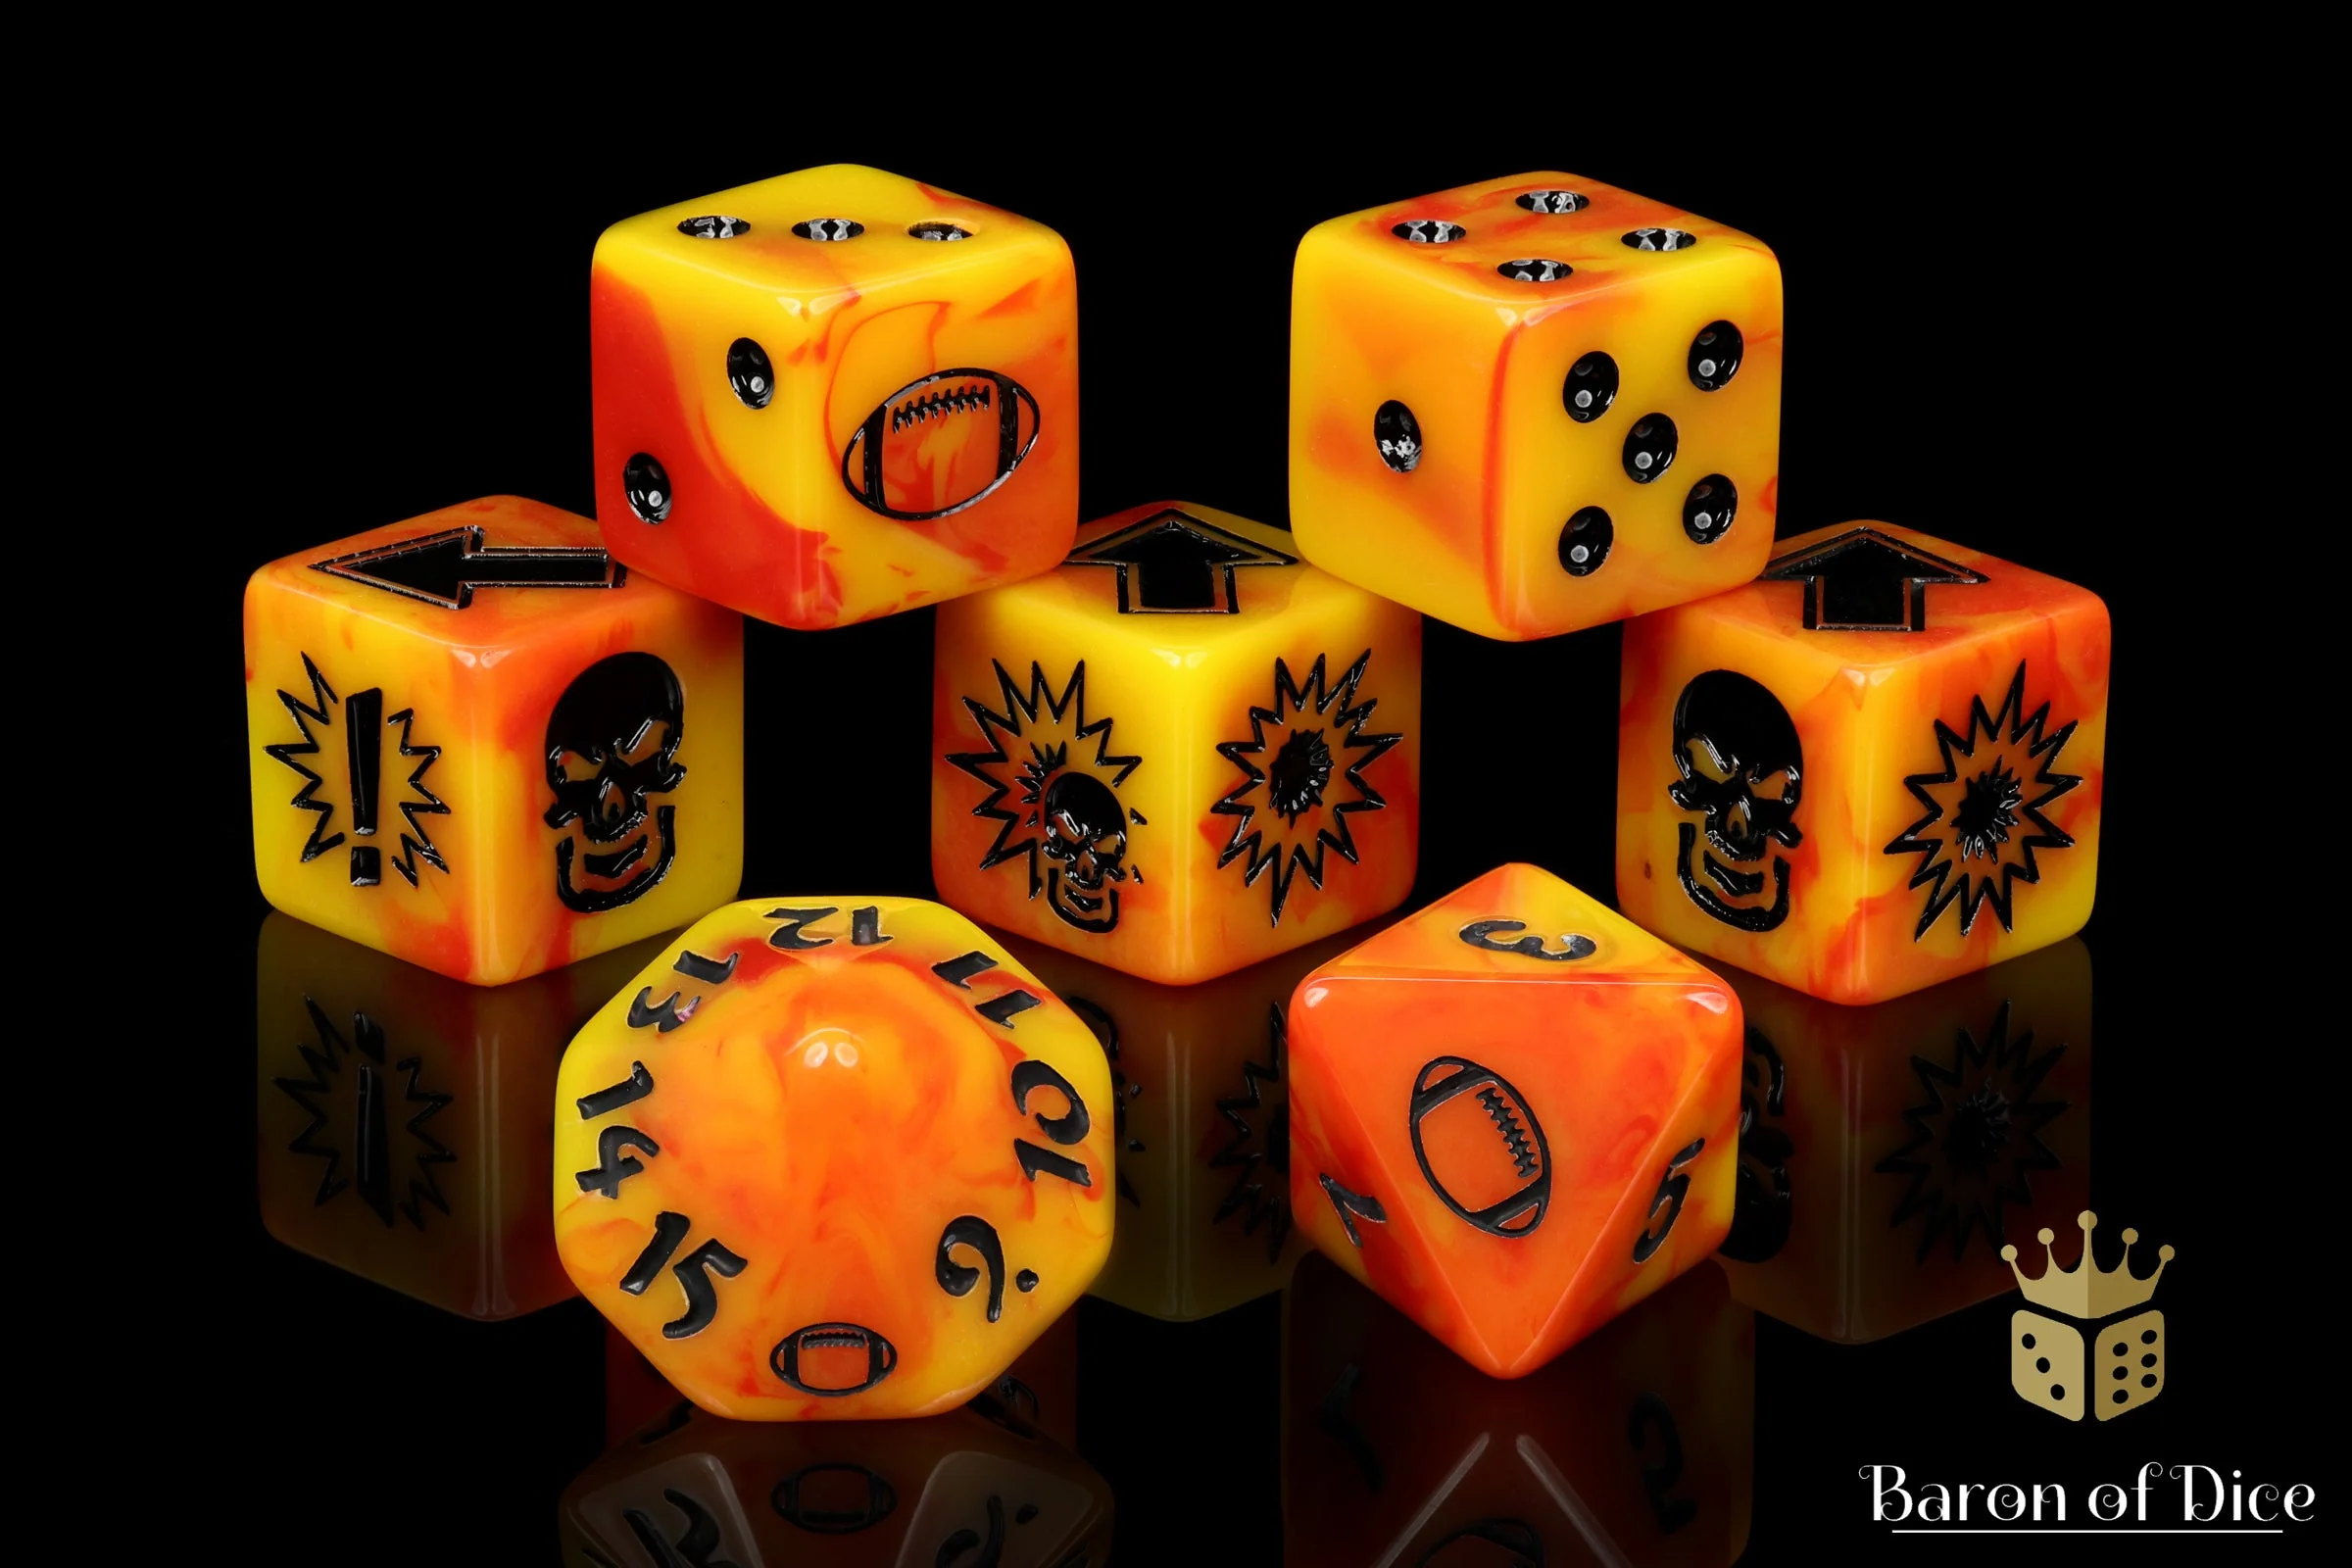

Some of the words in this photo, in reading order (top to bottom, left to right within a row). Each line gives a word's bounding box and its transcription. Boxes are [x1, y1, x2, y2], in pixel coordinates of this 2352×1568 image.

[762, 906, 894, 950] 12
[1458, 917, 1598, 961] 3
[627, 950, 742, 1033] 13
[930, 951, 1043, 1029] 11
[575, 1059, 660, 1199] 14
[1010, 1059, 1092, 1188] 10
[1632, 1137, 1706, 1264] 5
[619, 1210, 749, 1340] 15
